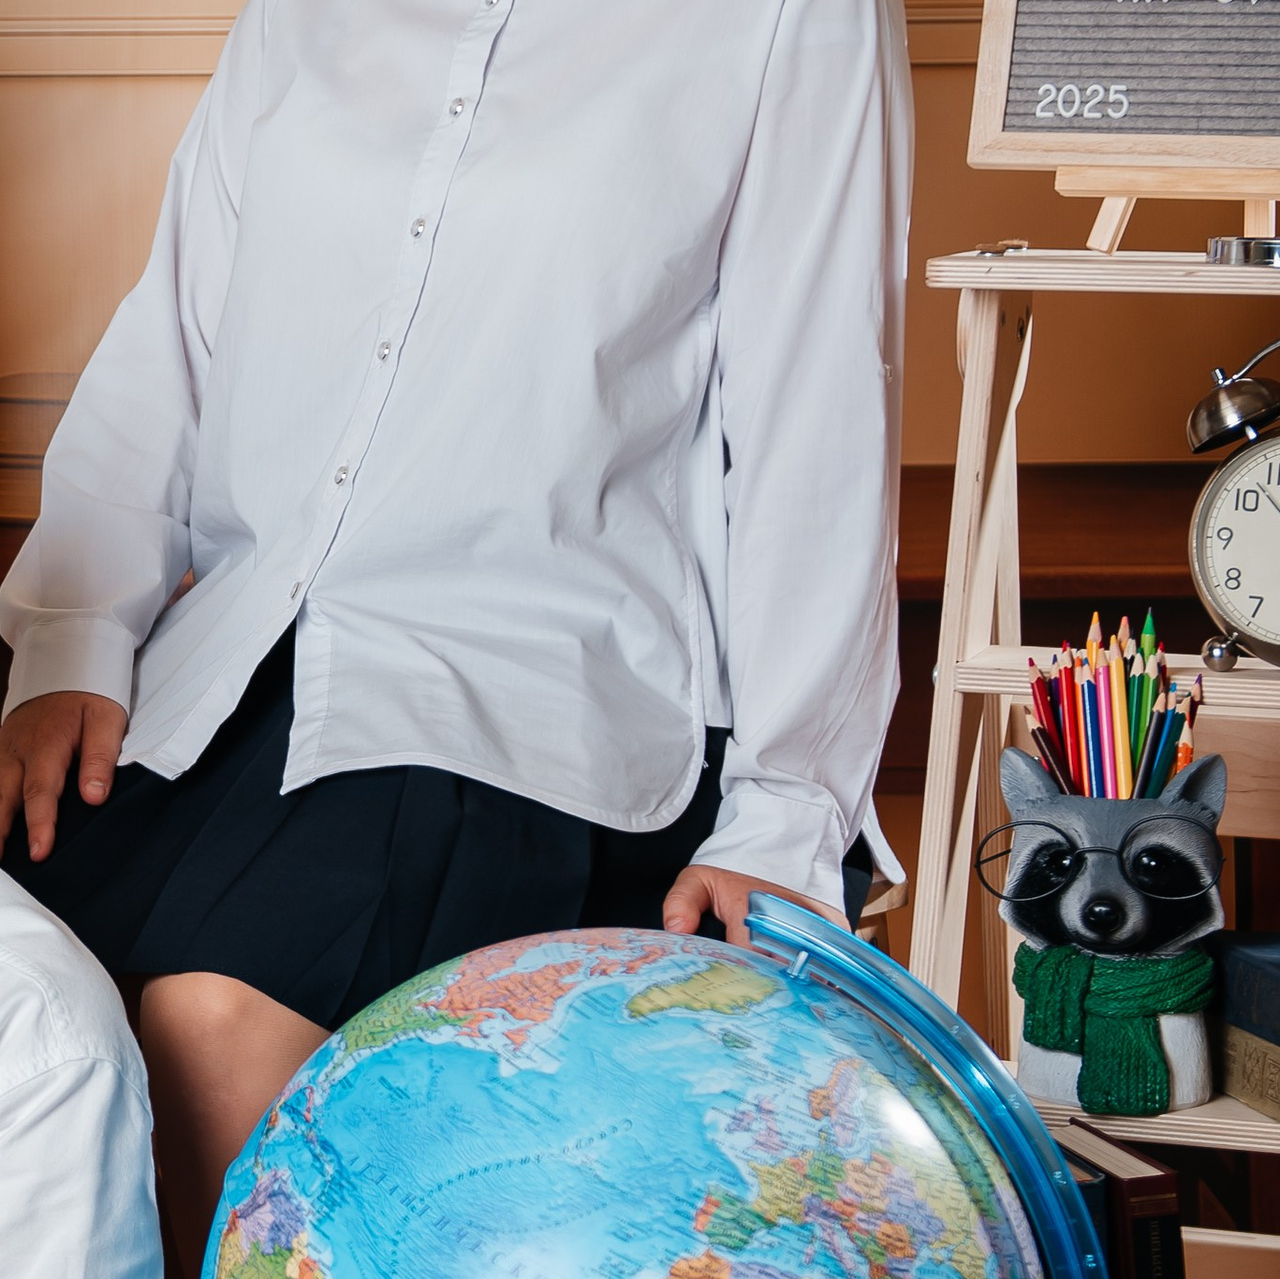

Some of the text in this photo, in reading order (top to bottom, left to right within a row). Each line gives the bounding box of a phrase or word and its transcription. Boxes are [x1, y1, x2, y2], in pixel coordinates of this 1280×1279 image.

[1035, 83, 1130, 119] 2025
[1234, 488, 1260, 513] 10
[1216, 526, 1234, 551] 9
[1224, 567, 1242, 591] 8
[1248, 595, 1265, 619] 7
